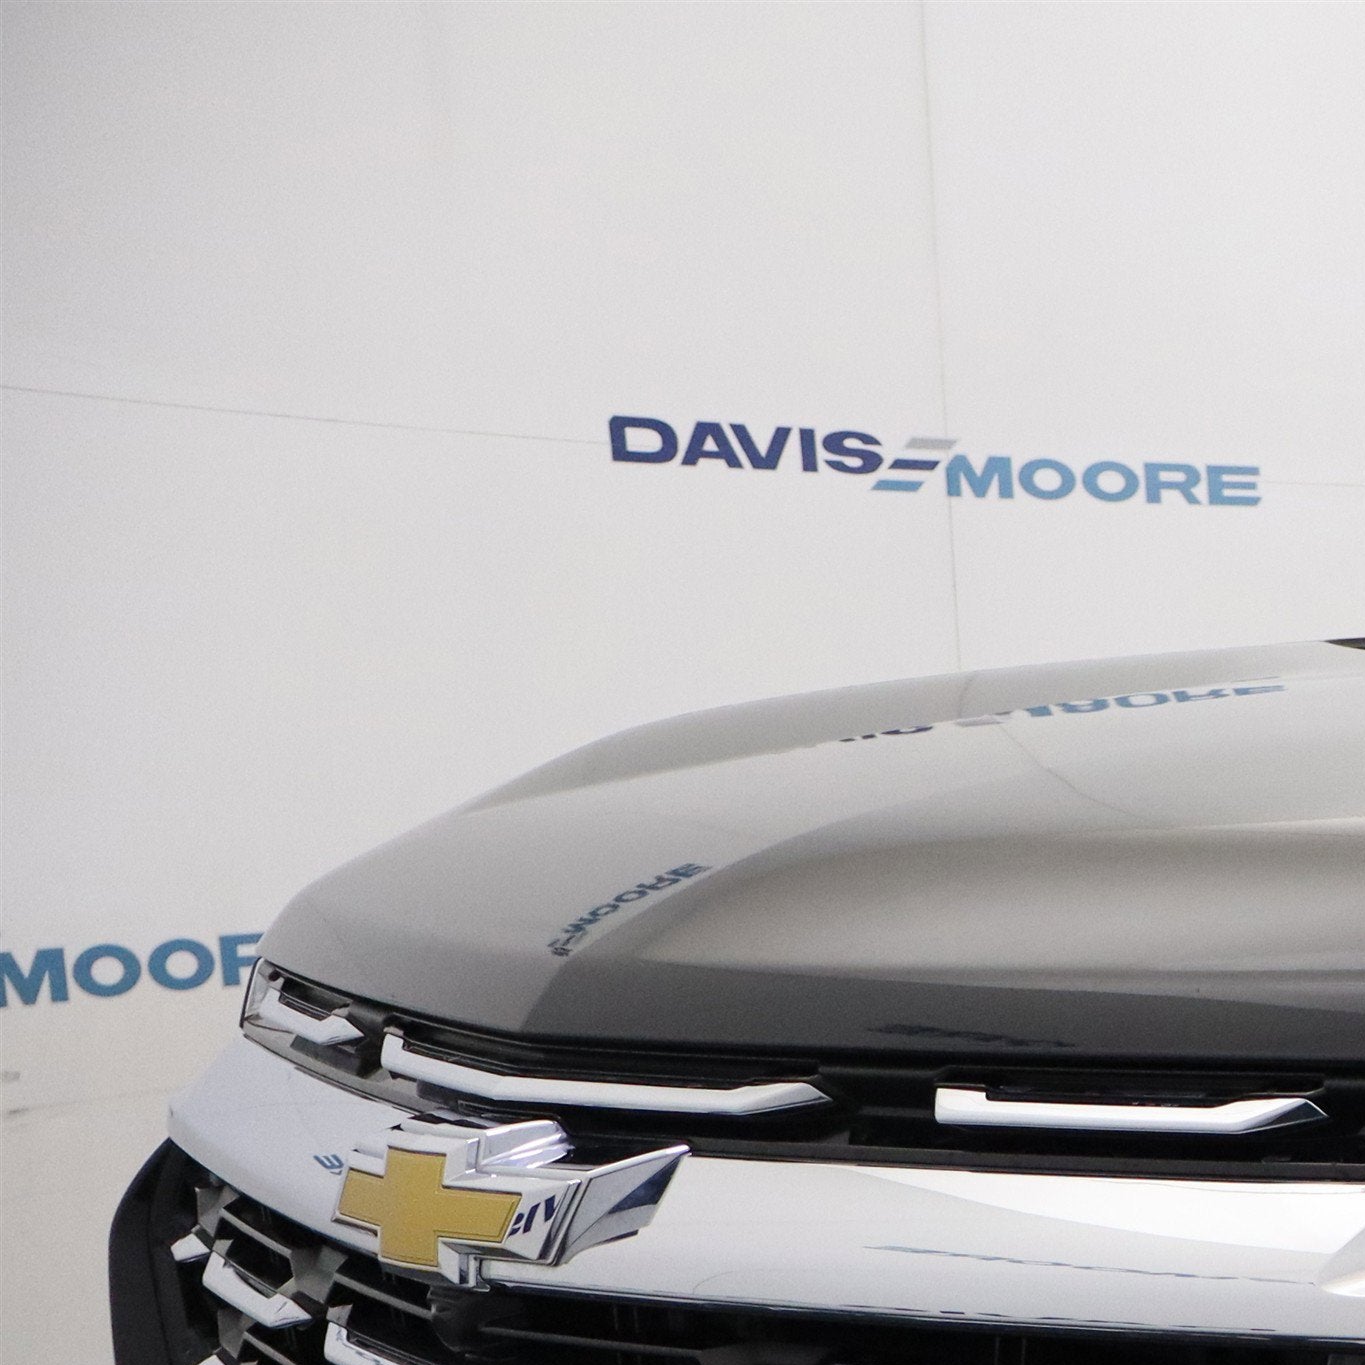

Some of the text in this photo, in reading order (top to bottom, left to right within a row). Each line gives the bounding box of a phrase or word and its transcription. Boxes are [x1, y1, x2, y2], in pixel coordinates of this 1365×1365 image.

[609, 414, 1261, 506] DAVIS MOORE
[0, 931, 264, 1008] MOO
